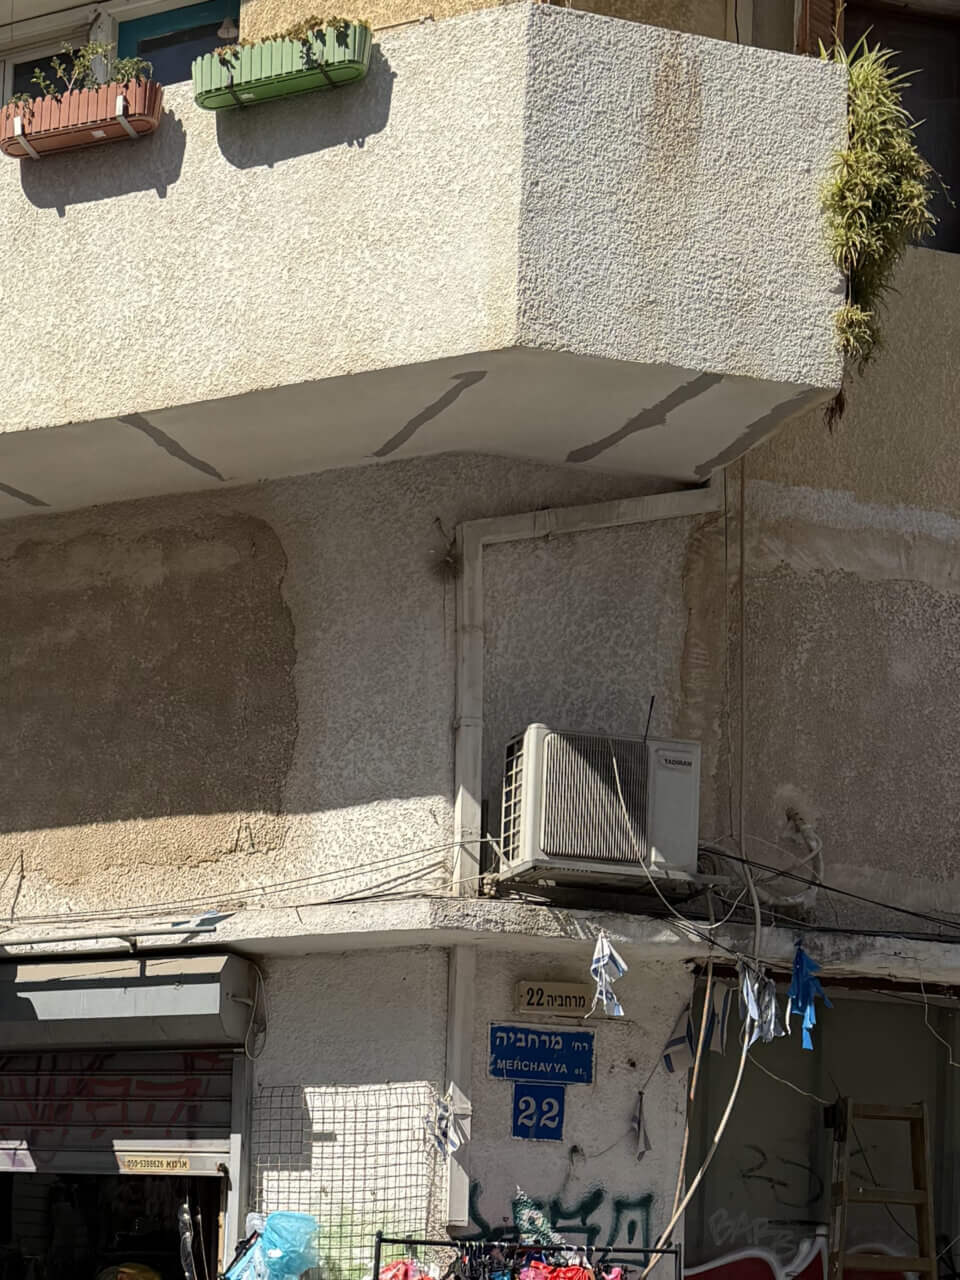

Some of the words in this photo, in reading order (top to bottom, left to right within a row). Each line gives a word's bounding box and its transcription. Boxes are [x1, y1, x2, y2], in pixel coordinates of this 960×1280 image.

[526, 987, 545, 1007] 22
[546, 994, 586, 1009] מרחביה
[495, 1031, 563, 1050] מרחביה
[496, 1058, 568, 1073] MERCHAVYA
[518, 1096, 559, 1129] 22
